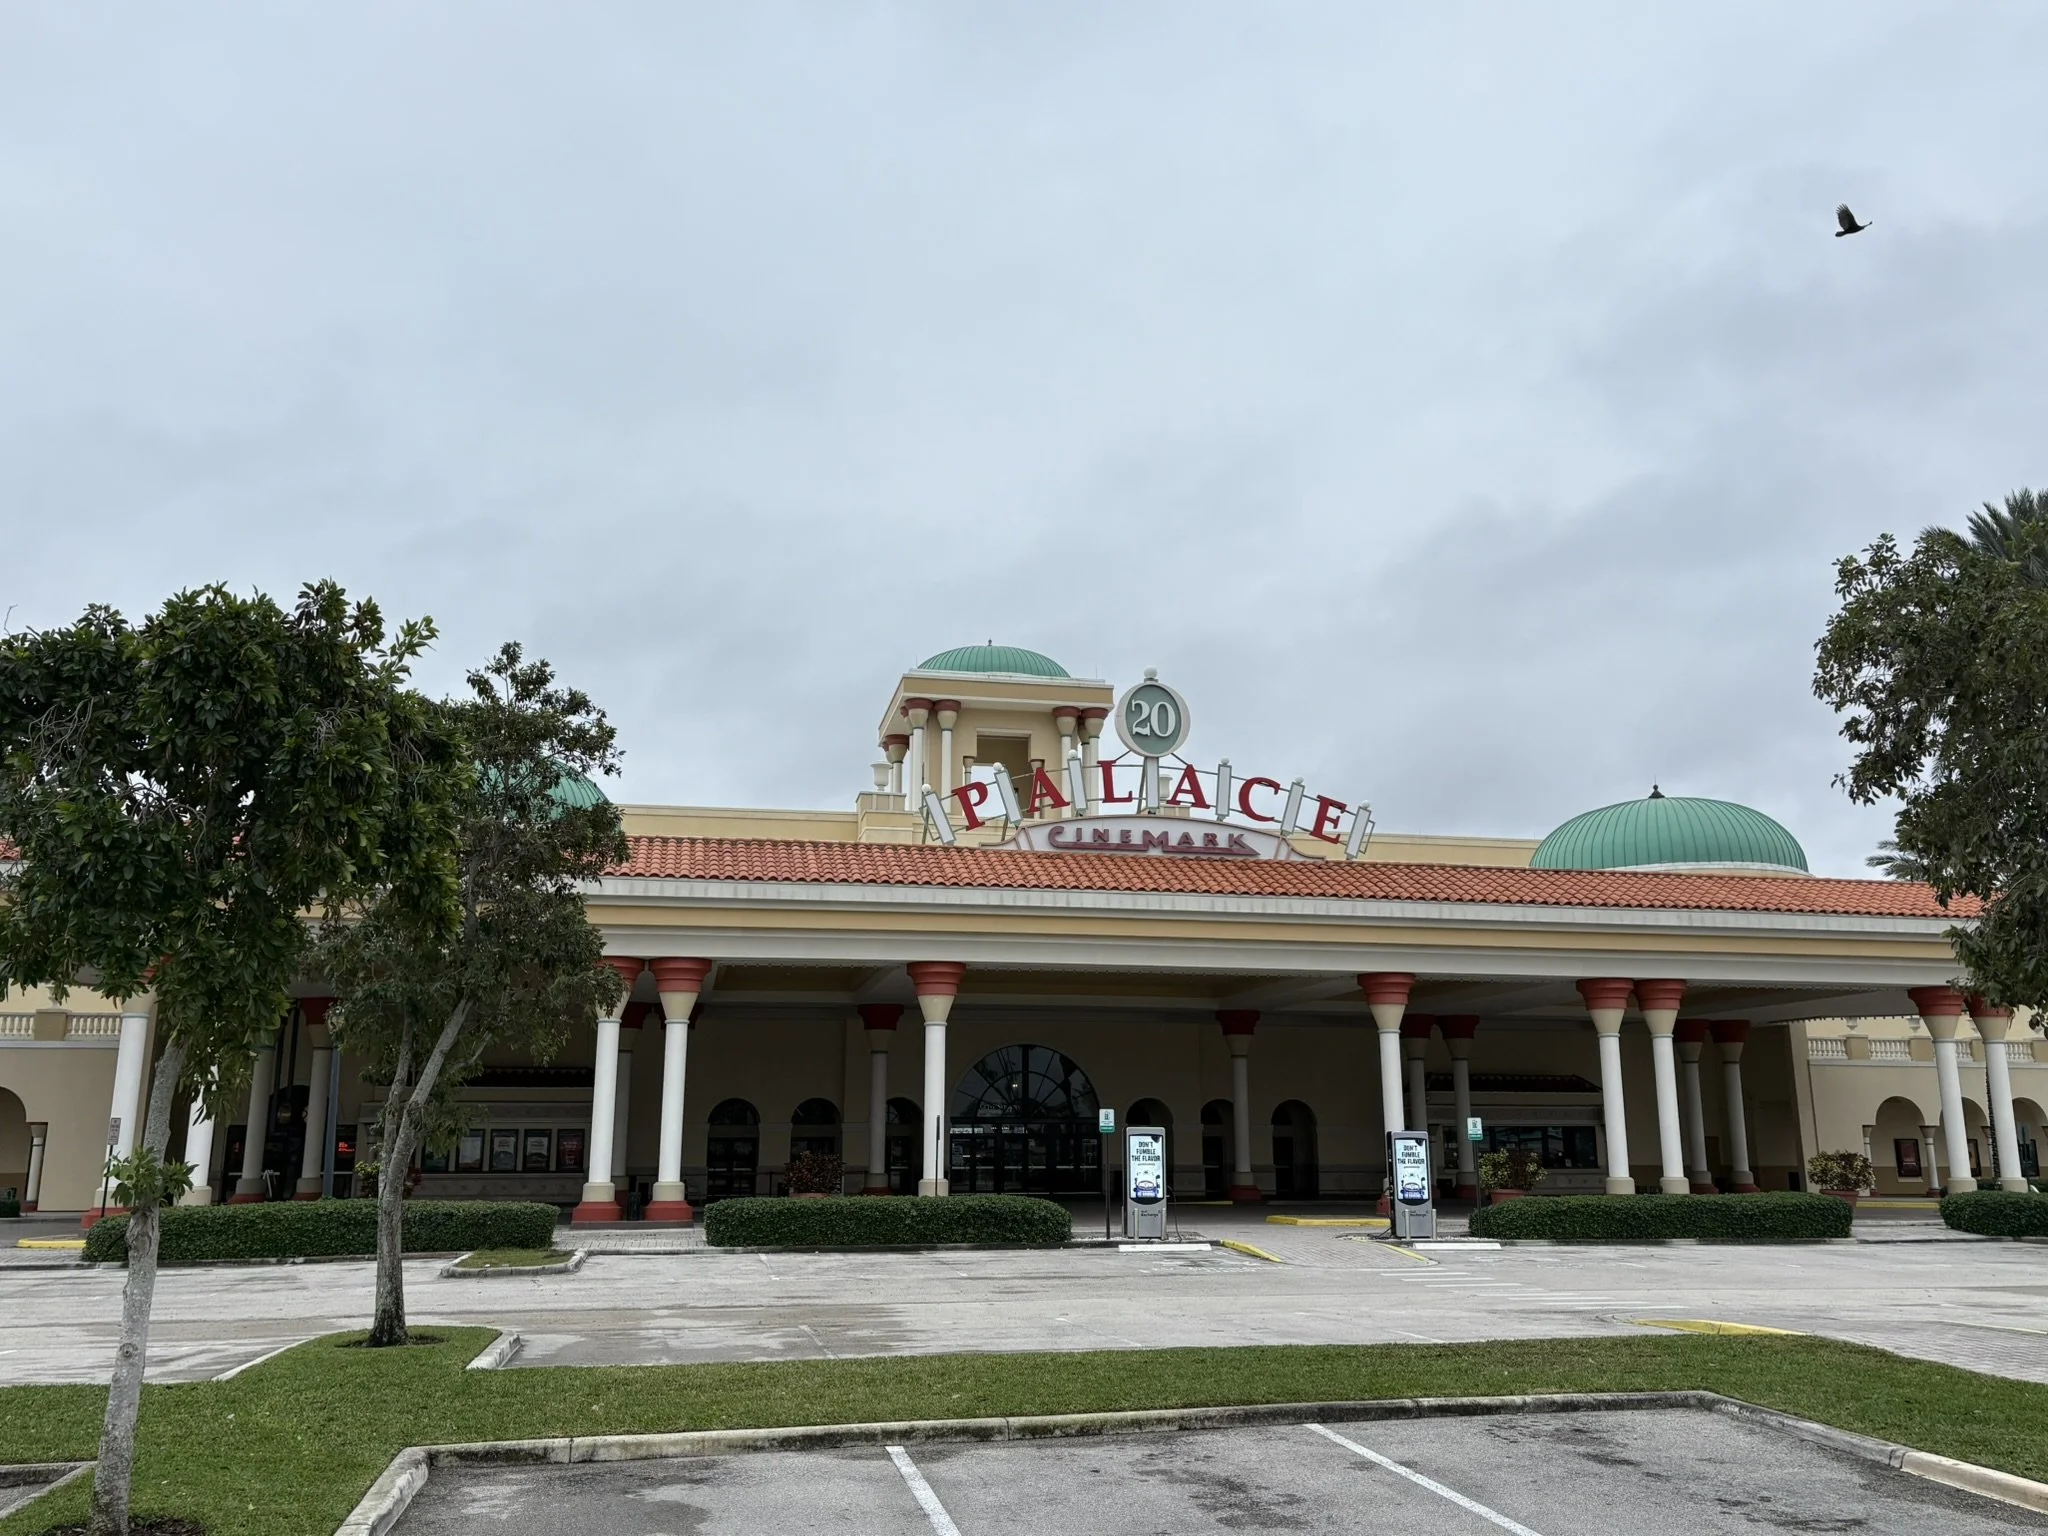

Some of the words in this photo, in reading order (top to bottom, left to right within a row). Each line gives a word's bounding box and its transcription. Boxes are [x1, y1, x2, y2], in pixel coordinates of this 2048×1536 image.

[1131, 699, 1177, 739] 20
[951, 759, 1347, 845] PALACE
[1048, 826, 1260, 856] CINEMARK
